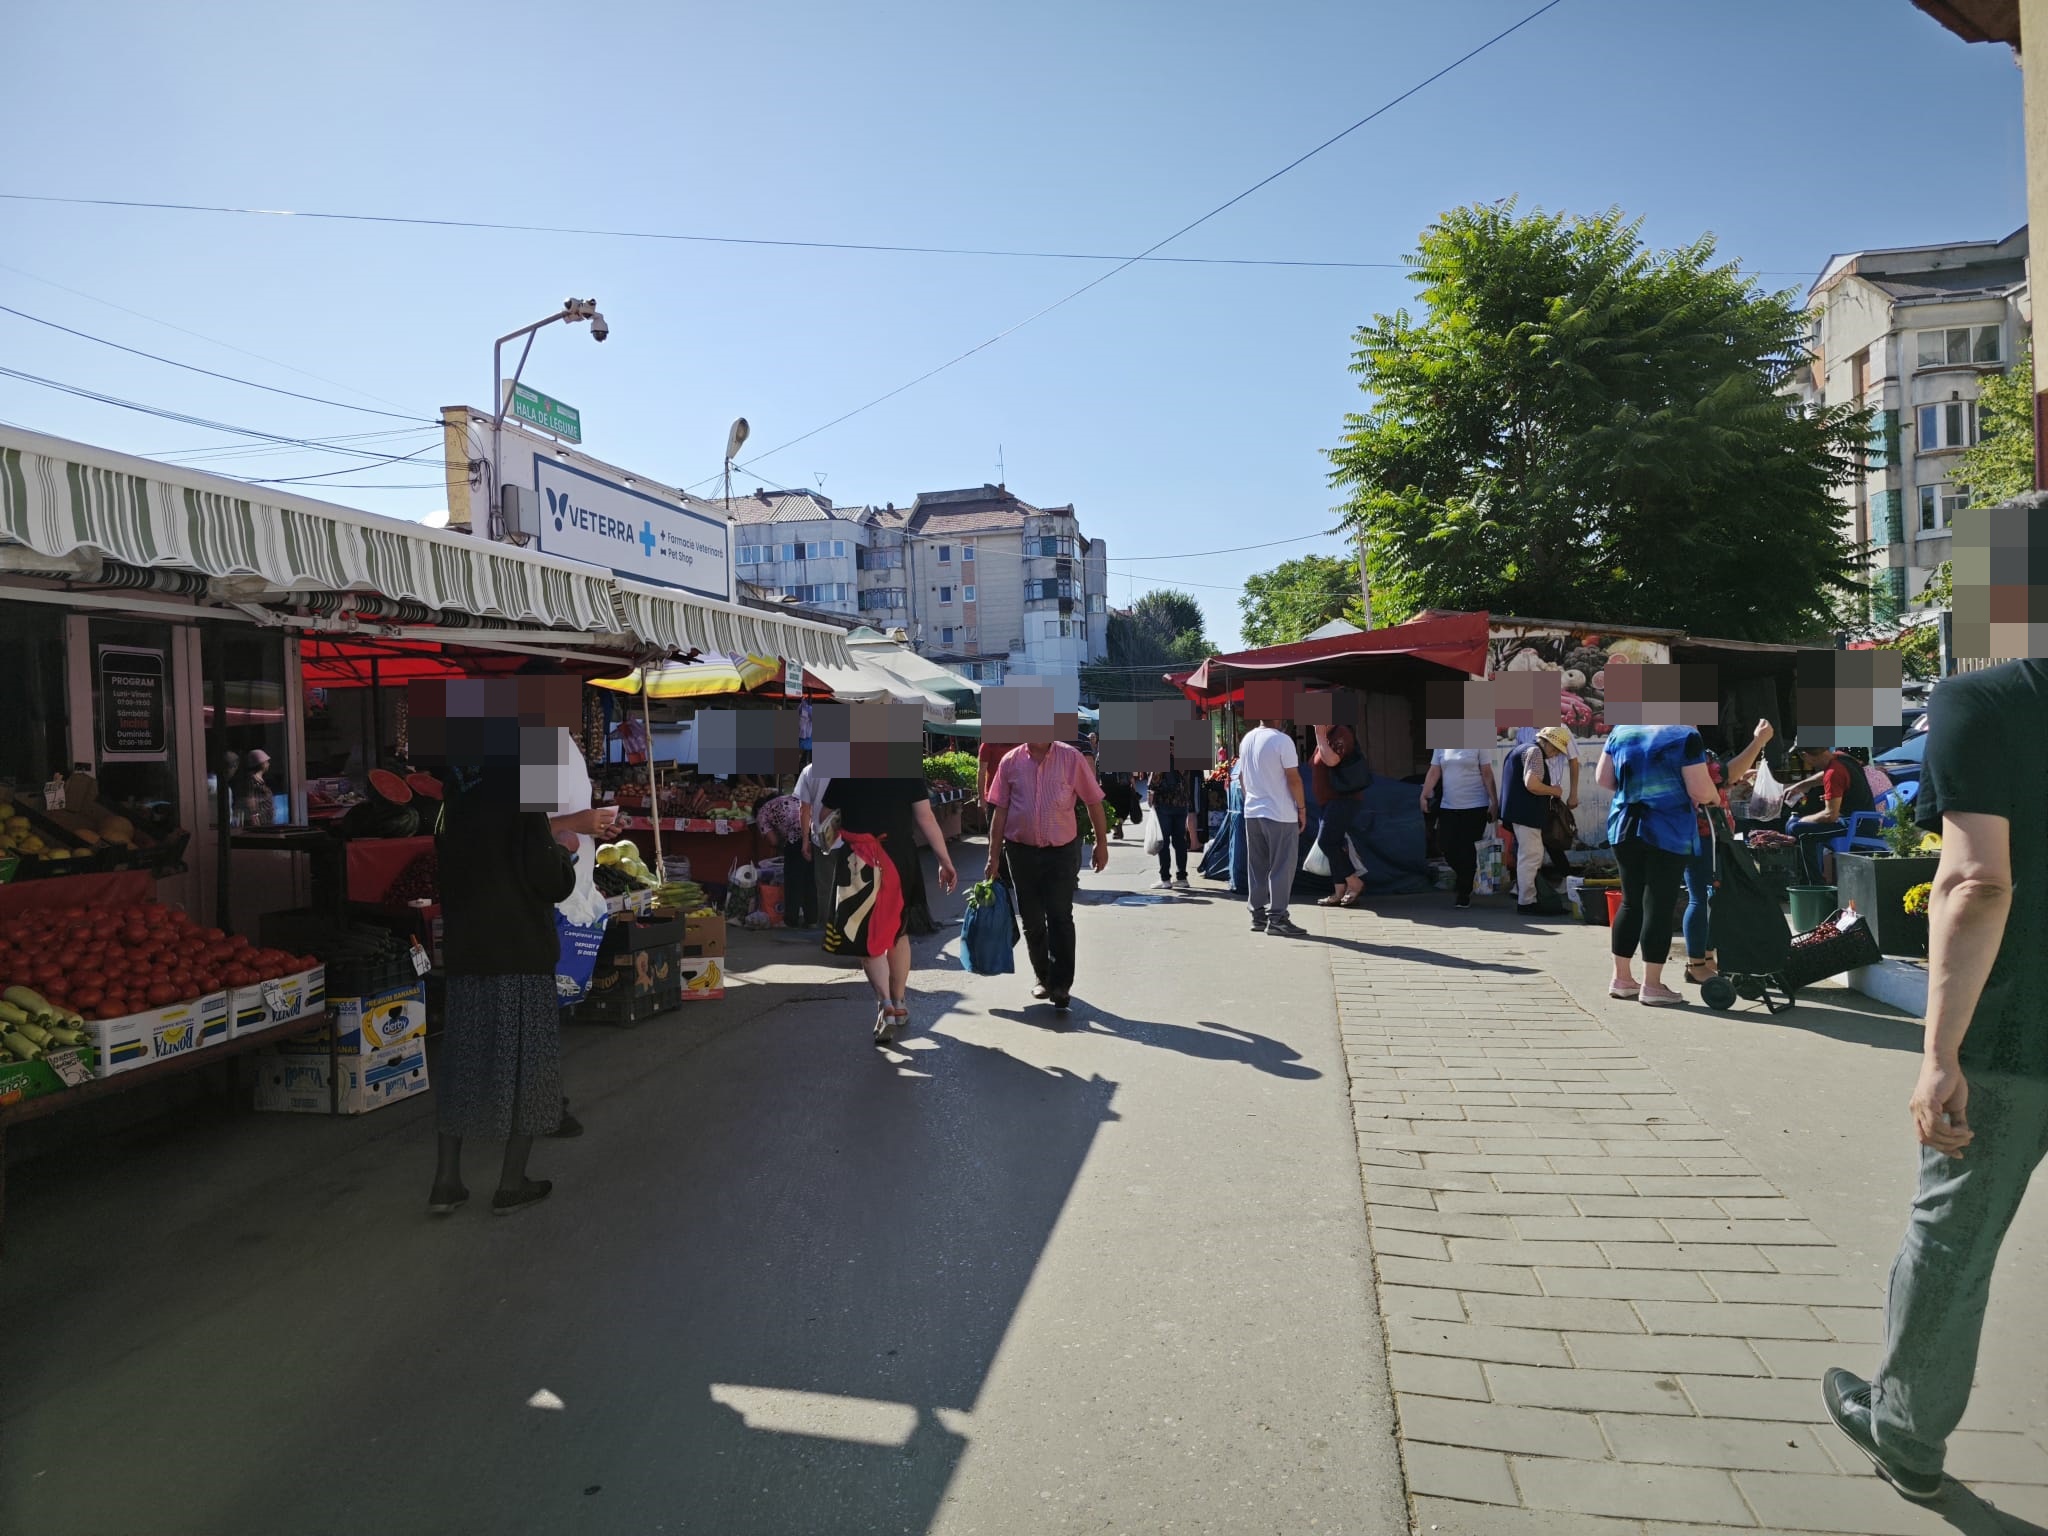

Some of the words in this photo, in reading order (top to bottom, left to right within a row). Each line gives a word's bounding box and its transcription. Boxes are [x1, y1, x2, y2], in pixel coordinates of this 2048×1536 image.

[516, 400, 537, 421] HALA
[538, 410, 549, 426] DE
[549, 415, 578, 438] LEGUME
[569, 504, 635, 544] VETERRA
[667, 532, 695, 550] Farmacie
[668, 548, 678, 560] Pet
[678, 551, 693, 567] Shop
[111, 676, 155, 687] PROGRAM
[383, 1016, 410, 1034] derby
[153, 1025, 194, 1058] BONITA
